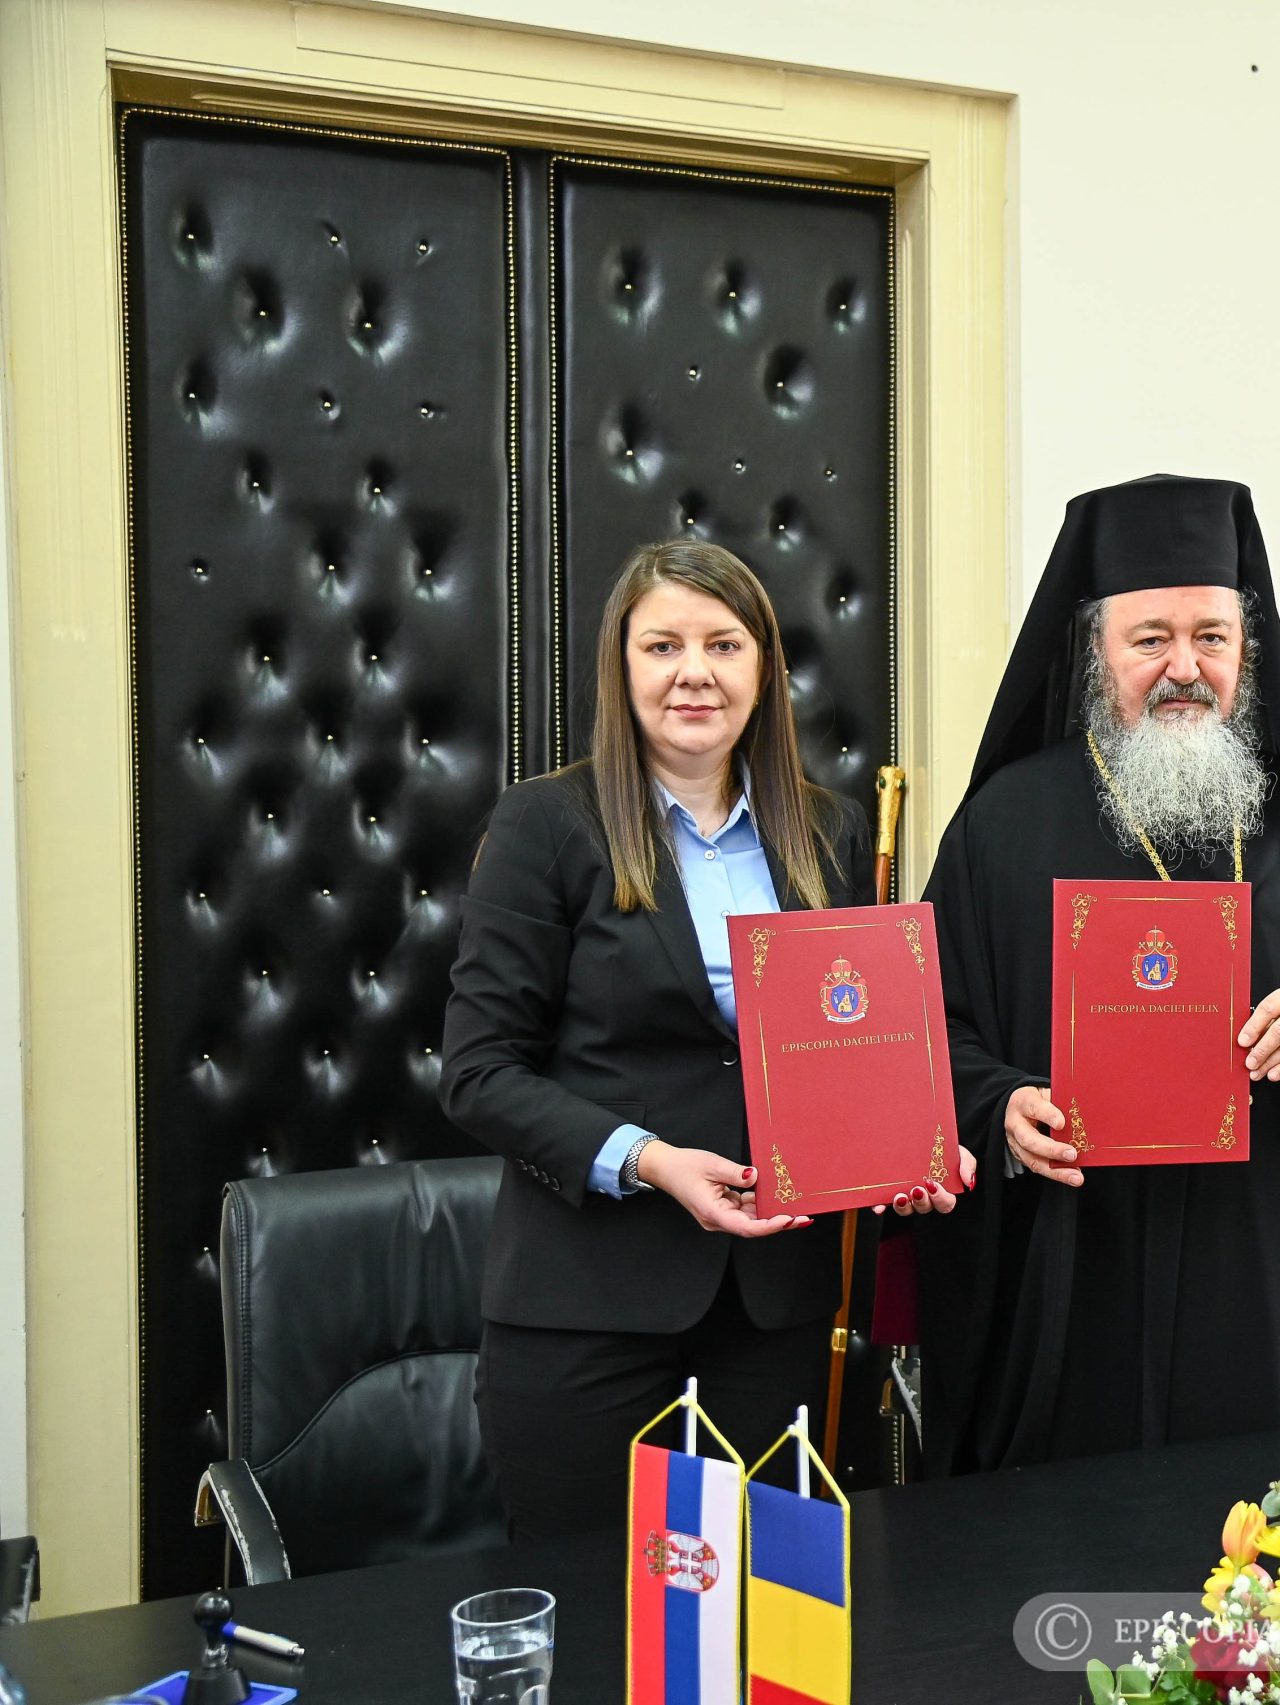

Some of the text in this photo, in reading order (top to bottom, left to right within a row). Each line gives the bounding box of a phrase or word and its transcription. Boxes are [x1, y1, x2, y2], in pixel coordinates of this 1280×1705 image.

[1090, 1004, 1219, 1014] EPISCOPIA DACIEI FELIX
[781, 1031, 915, 1053] EPISCOPIA DACIEI FELIX
